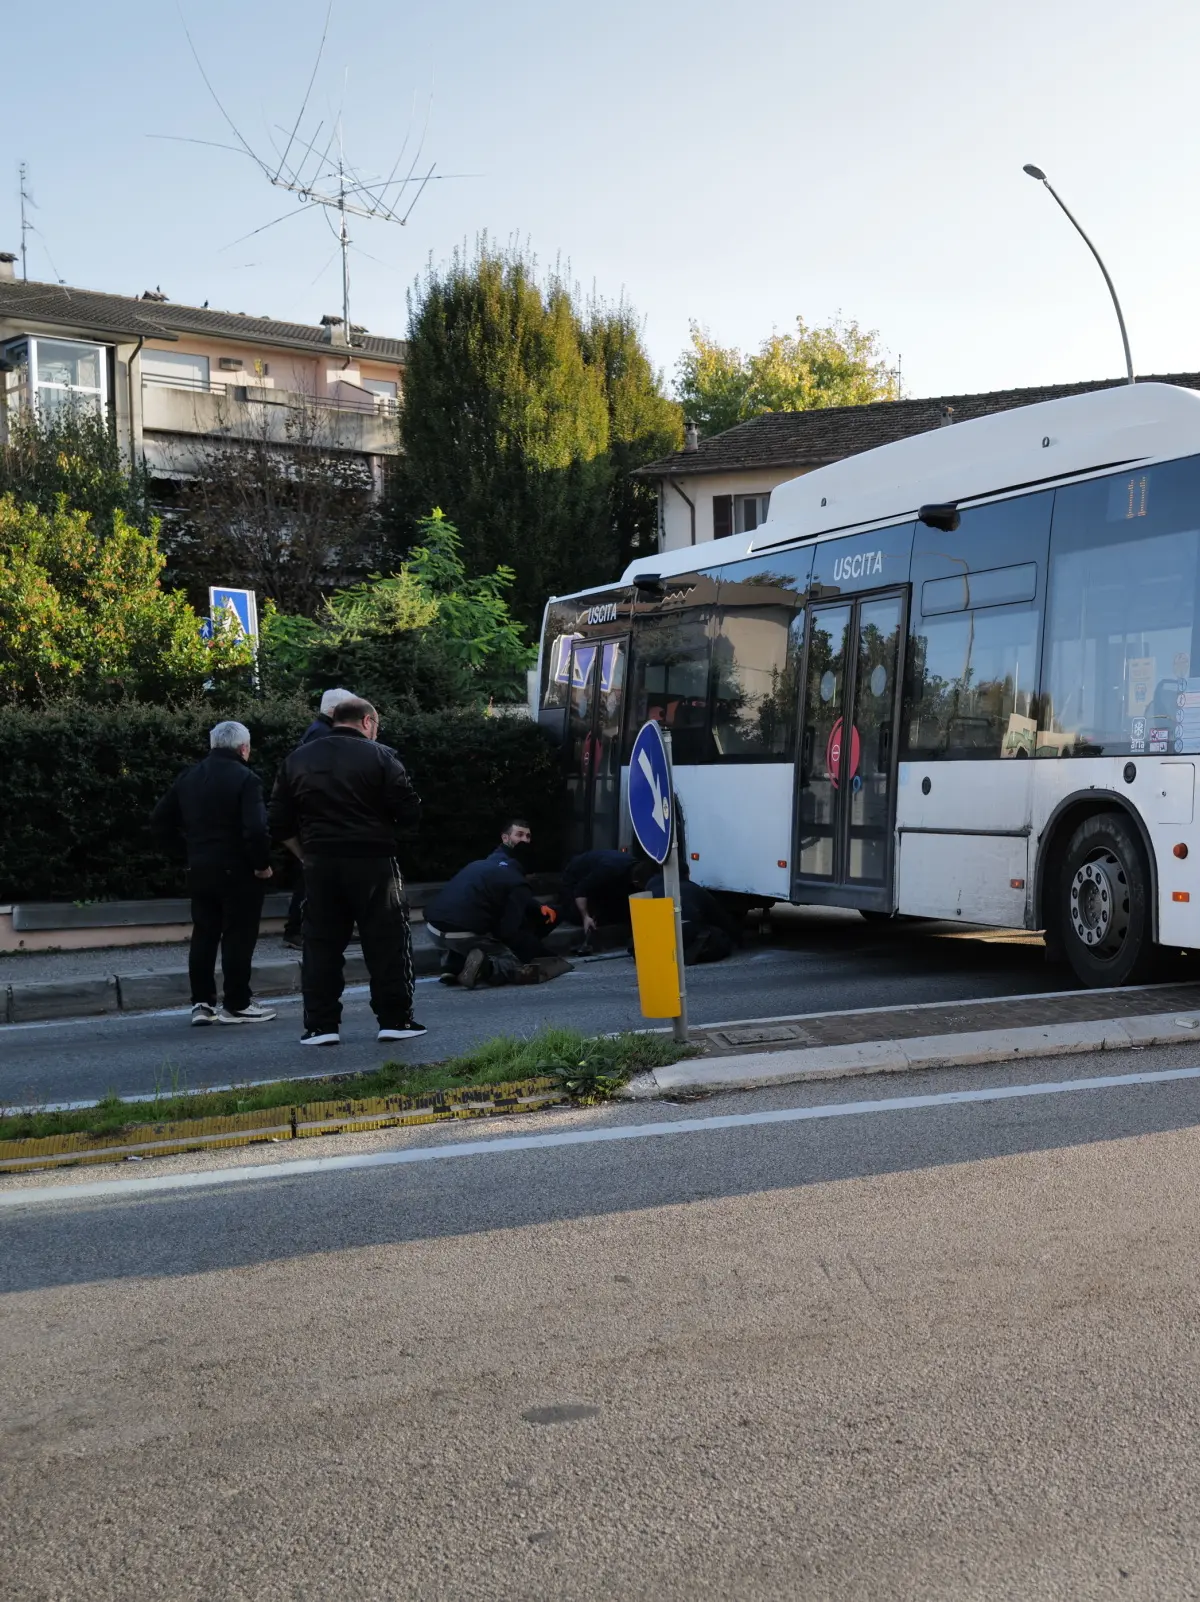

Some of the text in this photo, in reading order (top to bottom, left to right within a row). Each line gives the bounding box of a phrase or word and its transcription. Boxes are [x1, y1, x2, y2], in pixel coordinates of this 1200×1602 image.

[1126, 476, 1148, 519] 11
[833, 550, 884, 581] USCITA
[587, 603, 618, 625] USCITA
